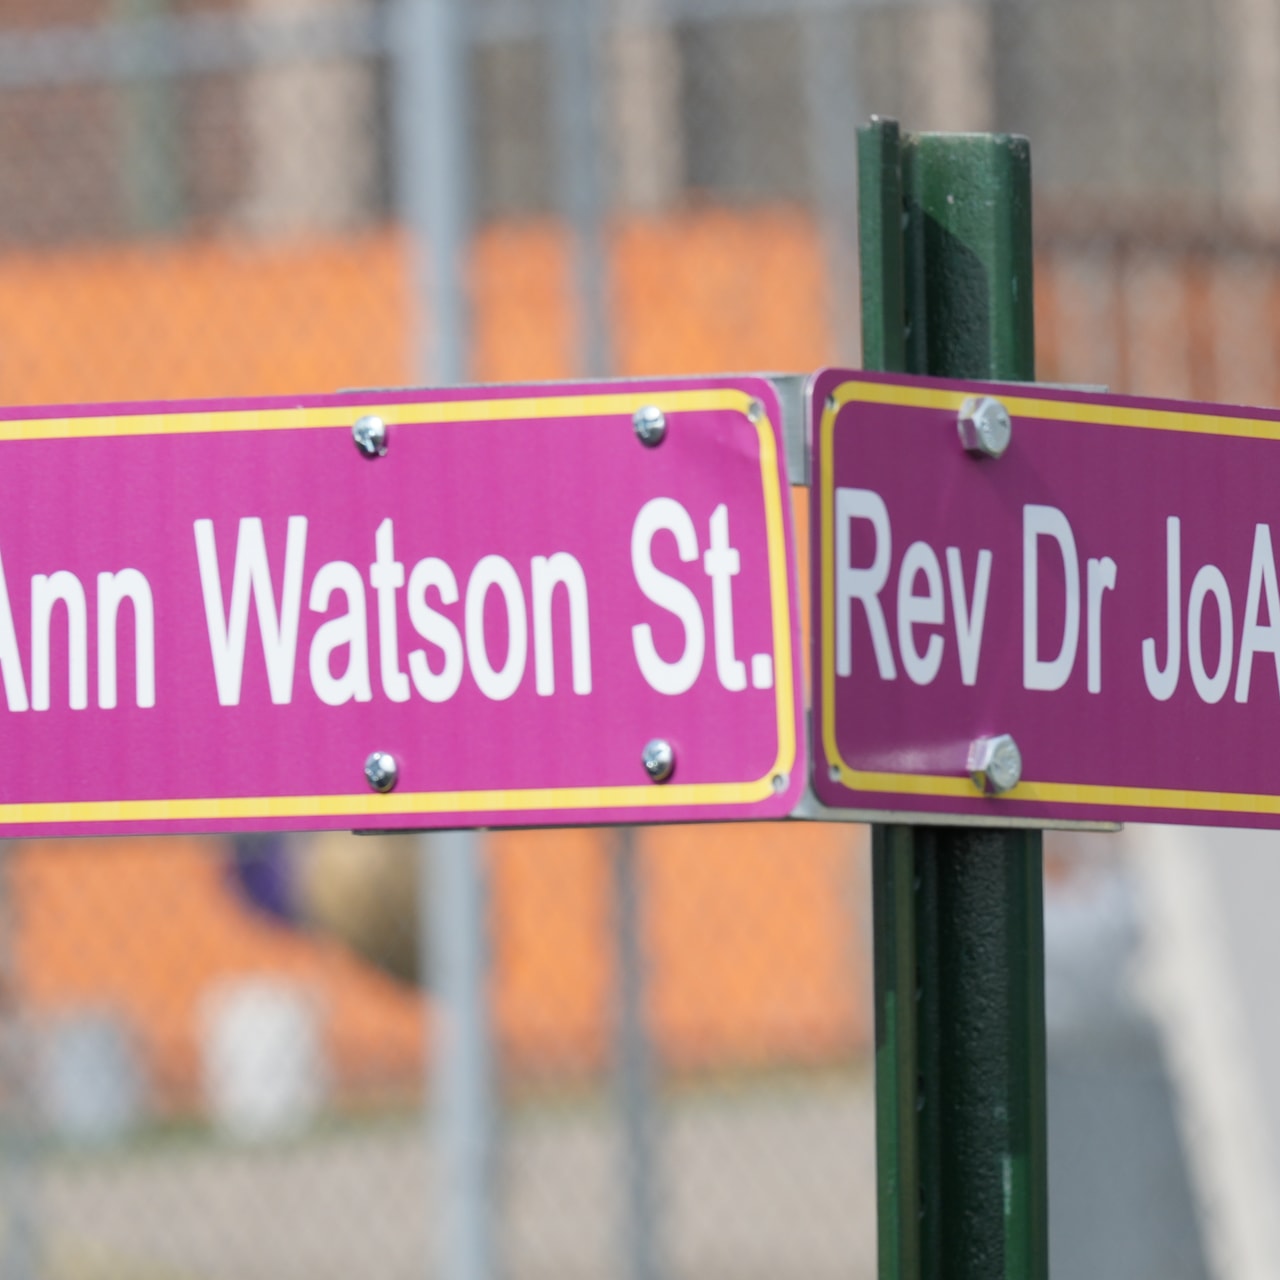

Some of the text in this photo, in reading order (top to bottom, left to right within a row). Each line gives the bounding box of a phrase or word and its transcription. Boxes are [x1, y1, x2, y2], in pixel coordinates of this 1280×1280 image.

[193, 514, 592, 706] Watson
[630, 496, 773, 695] St.
[835, 486, 992, 685] Rev
[1023, 504, 1117, 694] Dr
